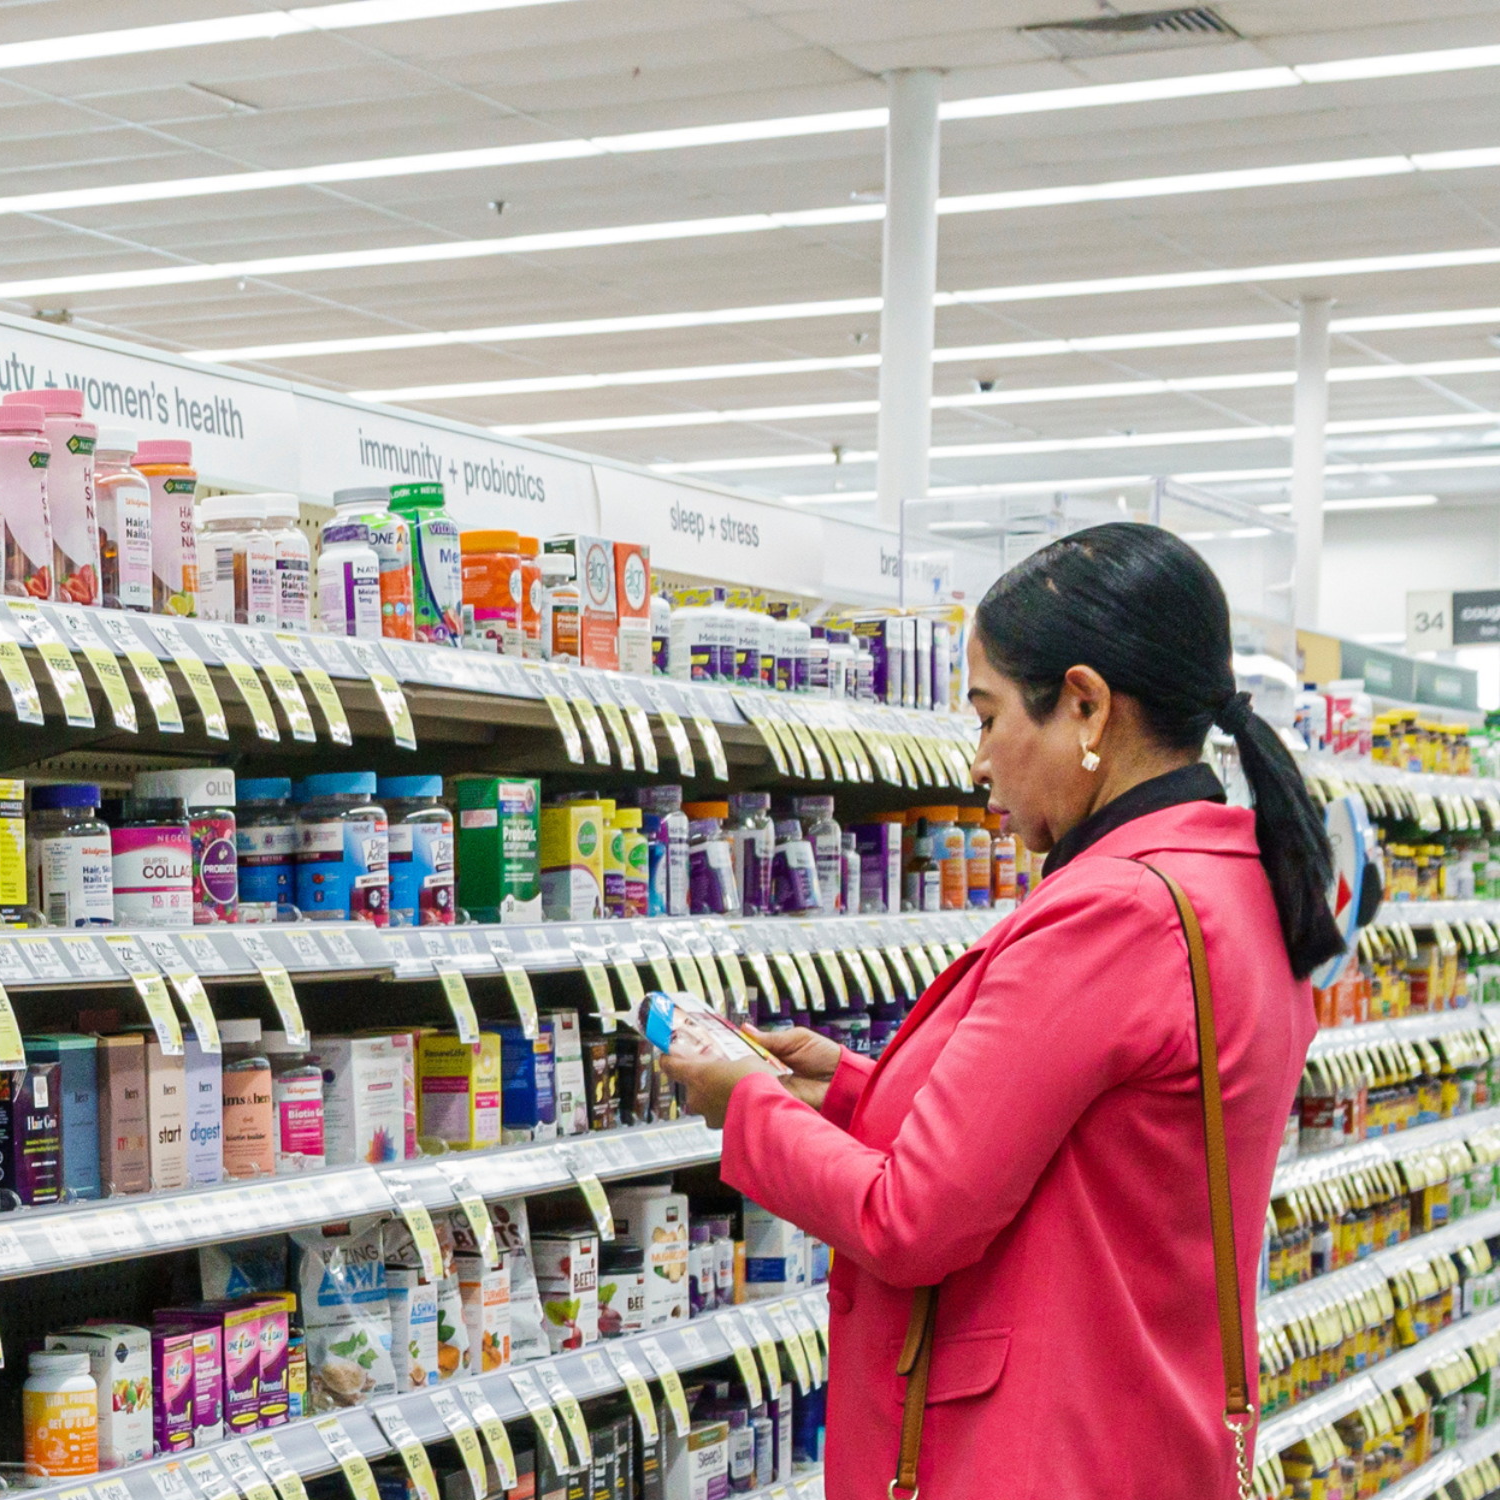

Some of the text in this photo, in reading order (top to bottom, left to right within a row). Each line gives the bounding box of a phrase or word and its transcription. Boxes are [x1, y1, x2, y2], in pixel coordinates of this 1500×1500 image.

[175, 385, 245, 439] health
[359, 429, 443, 483] immunity
[464, 461, 546, 504] probiotics
[670, 501, 705, 540] sleep
[721, 513, 760, 547] stress
[1414, 612, 1444, 633] 34
[206, 781, 233, 797] OLLY
[158, 1123, 182, 1144] start
[190, 1120, 221, 1142] digest
